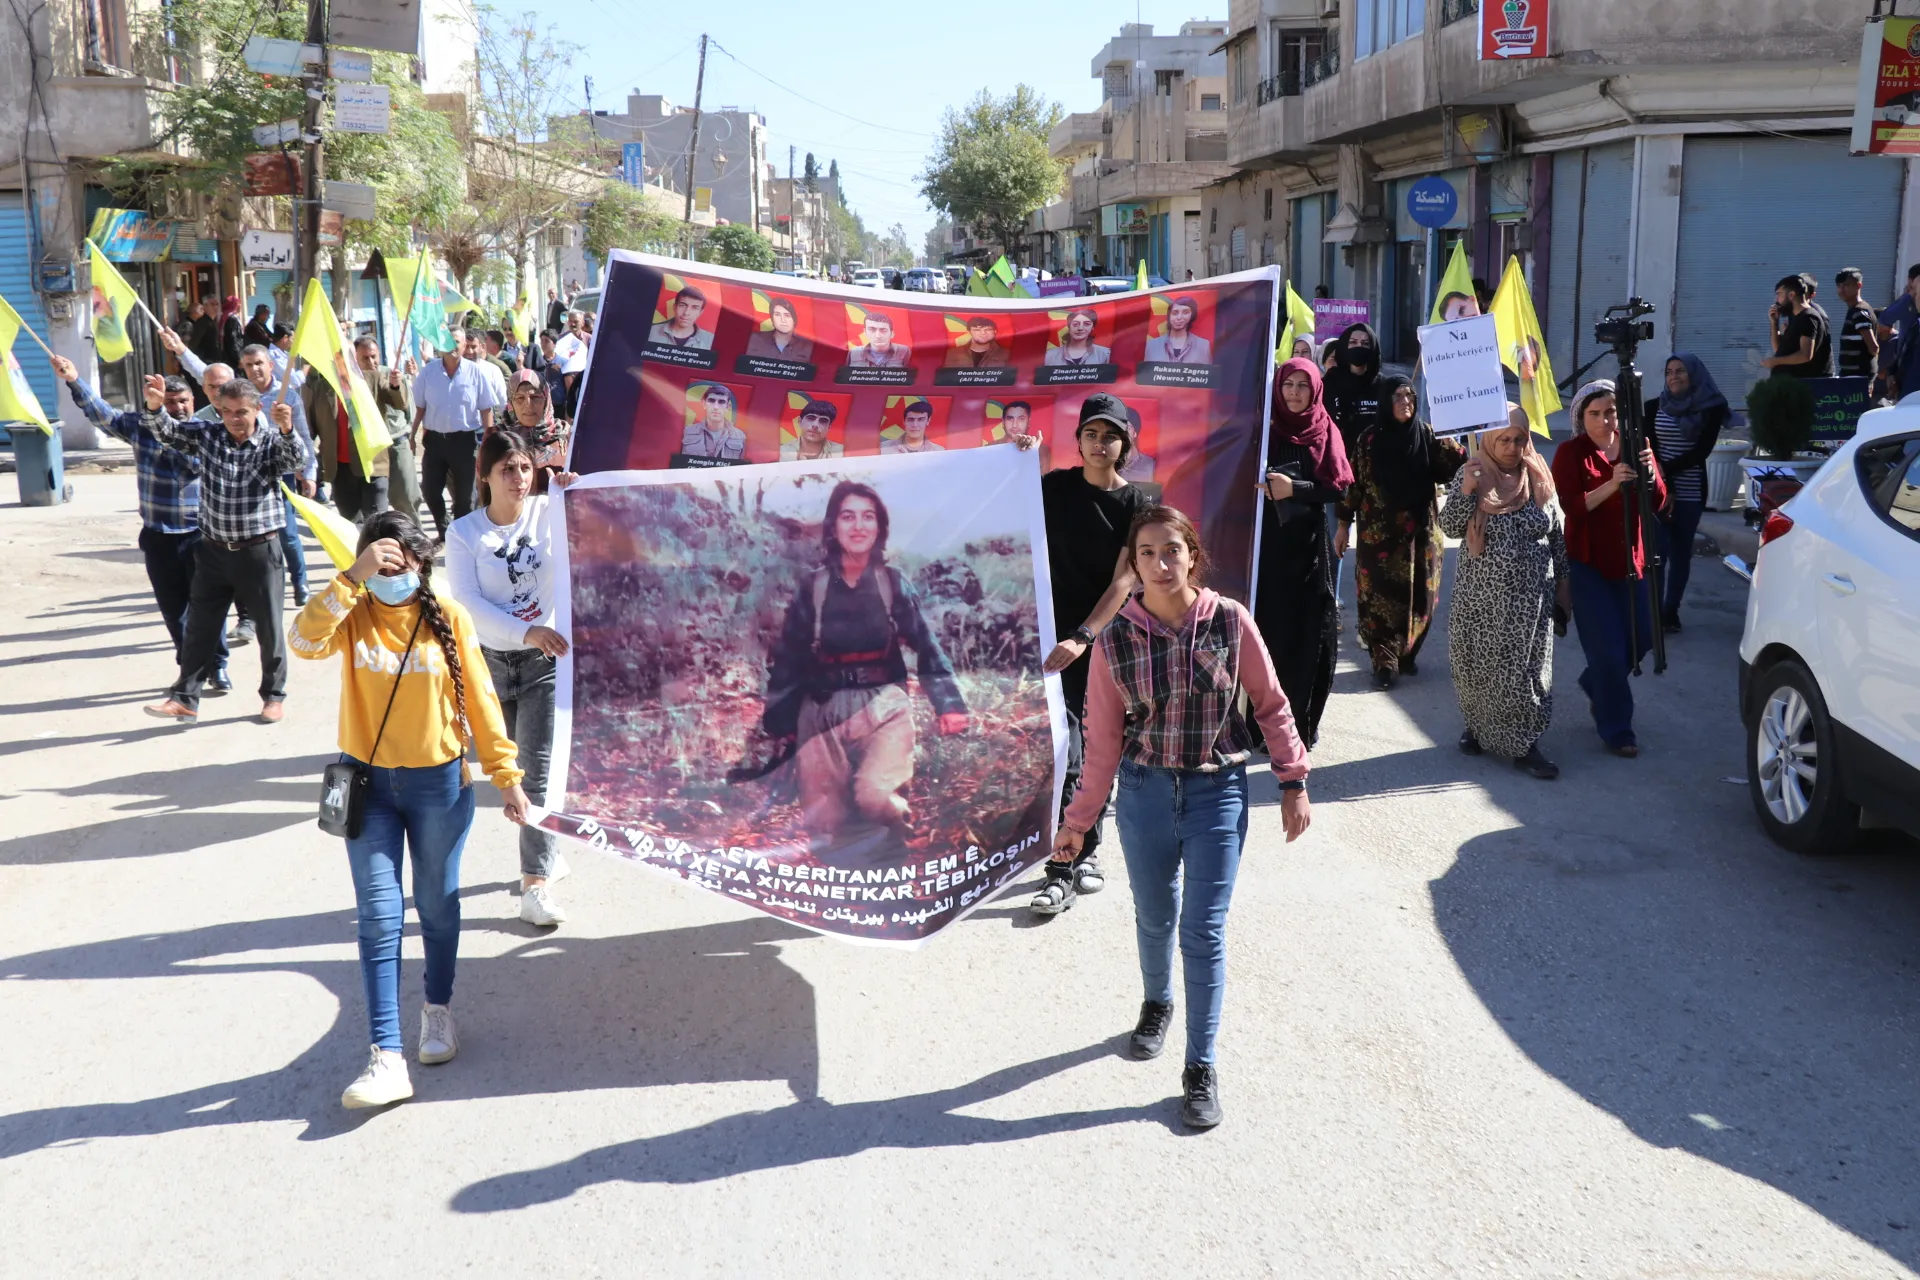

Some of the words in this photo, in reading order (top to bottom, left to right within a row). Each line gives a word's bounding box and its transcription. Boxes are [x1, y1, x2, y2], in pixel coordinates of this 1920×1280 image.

[1881, 65, 1909, 78] IZLA
[1881, 80, 1909, 88] TOURS
[1414, 190, 1450, 204] الحسكة
[1449, 330, 1468, 342] Na
[1427, 355, 1434, 364] ji
[1436, 352, 1455, 362] dakr
[1485, 345, 1495, 353] re
[1182, 367, 1210, 375] Zagros
[1433, 393, 1464, 405] bimre
[924, 854, 957, 876] EM
[965, 845, 979, 864] Ê
[688, 852, 751, 884] XETA
[756, 873, 914, 902] XIYANETKAR
